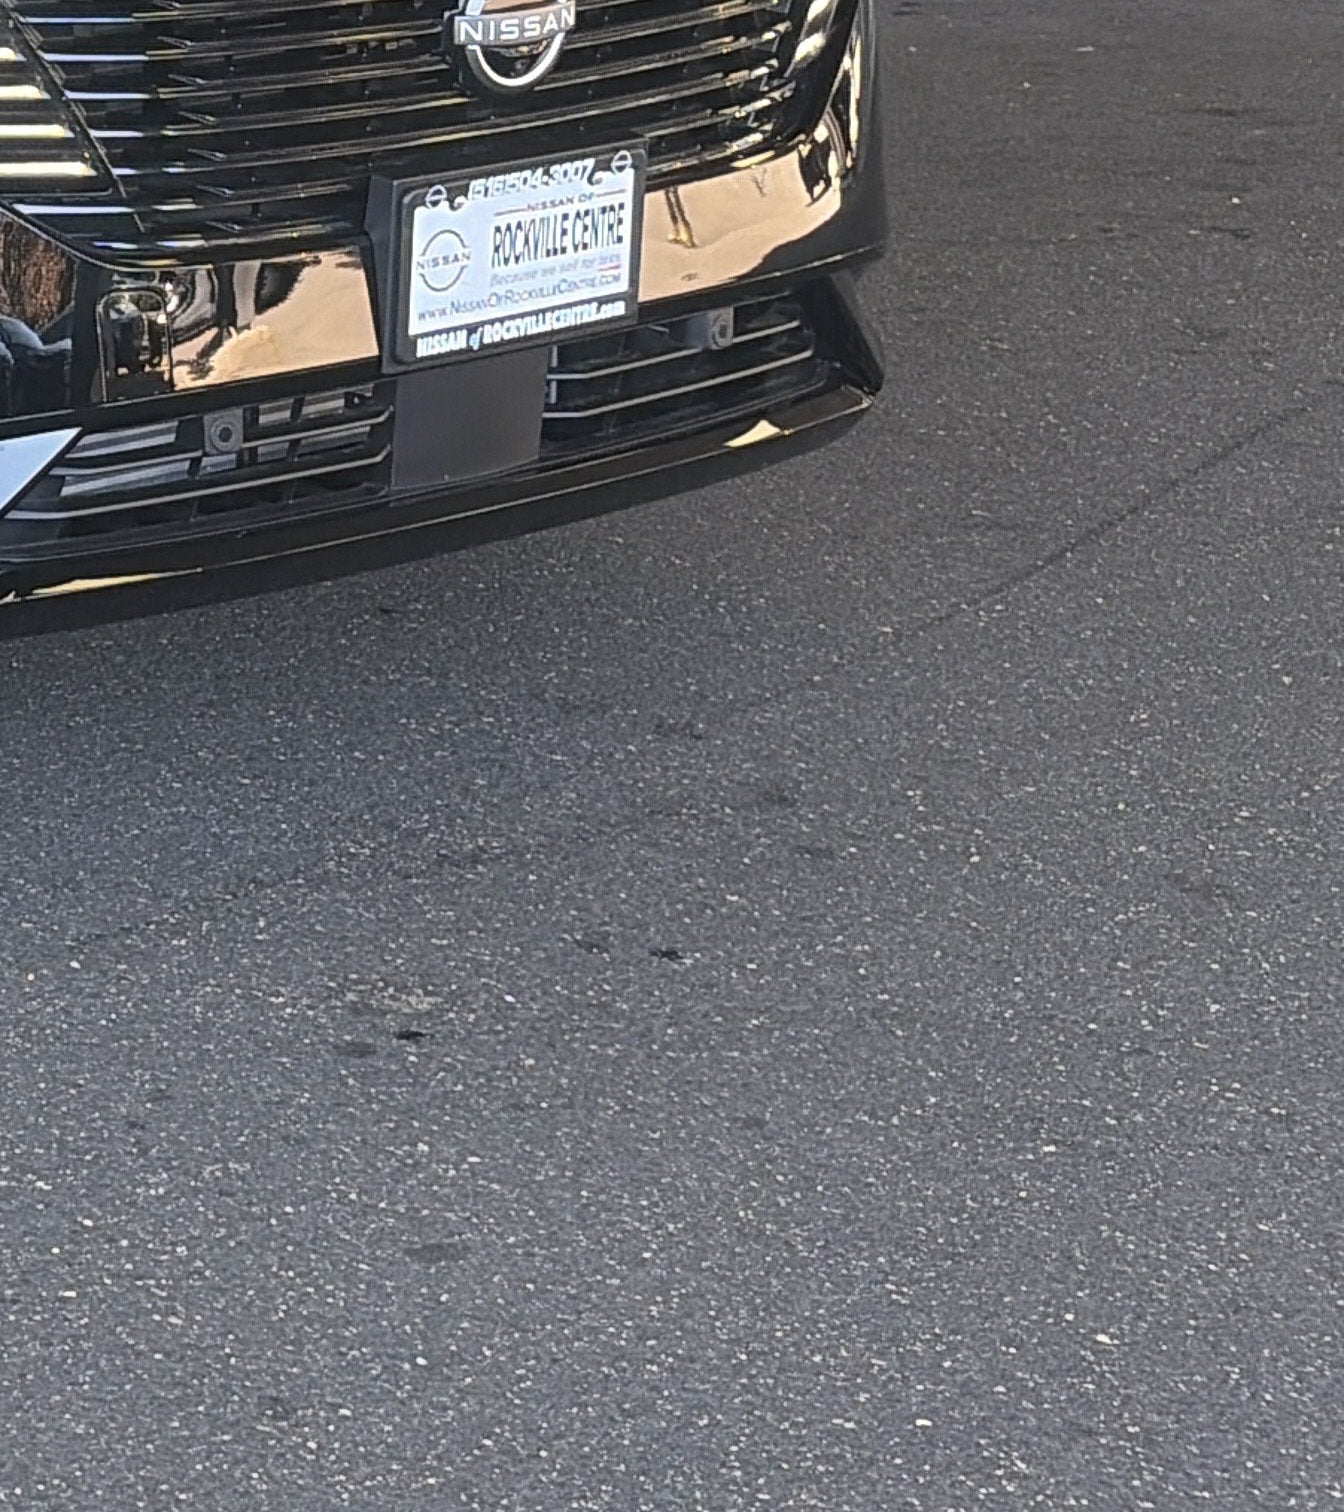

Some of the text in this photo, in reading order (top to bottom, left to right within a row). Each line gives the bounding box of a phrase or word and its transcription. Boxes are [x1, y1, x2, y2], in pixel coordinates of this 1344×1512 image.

[459, 0, 577, 42] NISSAN
[526, 195, 575, 212] NISSAN
[491, 201, 625, 269] ROCKVILLE CENTRE
[415, 247, 471, 271] NISSAN
[416, 328, 468, 359] NISSAN
[468, 325, 484, 350] of
